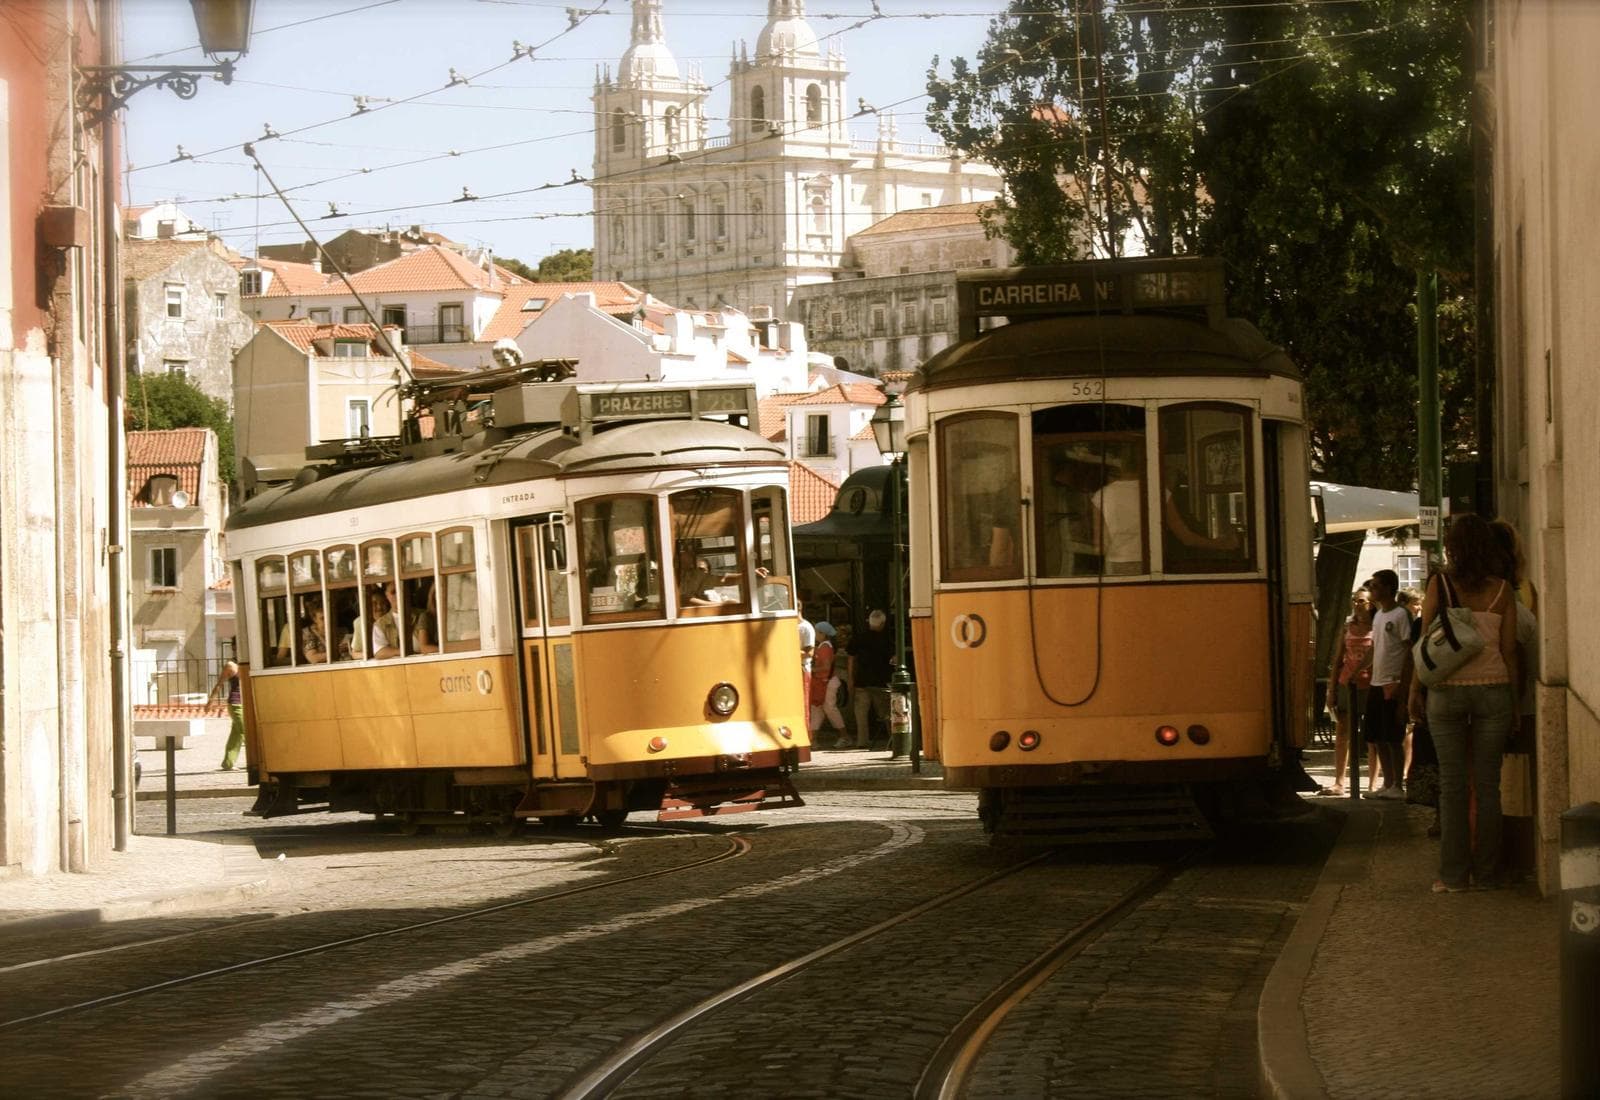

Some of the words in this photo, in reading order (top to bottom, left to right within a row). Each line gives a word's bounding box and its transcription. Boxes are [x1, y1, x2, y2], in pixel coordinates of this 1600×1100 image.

[979, 283, 1081, 306] CARREIRA
[1072, 381, 1102, 396] 562
[599, 394, 684, 412] PRAZERES
[706, 392, 737, 411] 28
[502, 492, 536, 505] ENTRADA
[440, 668, 473, 694] carris
